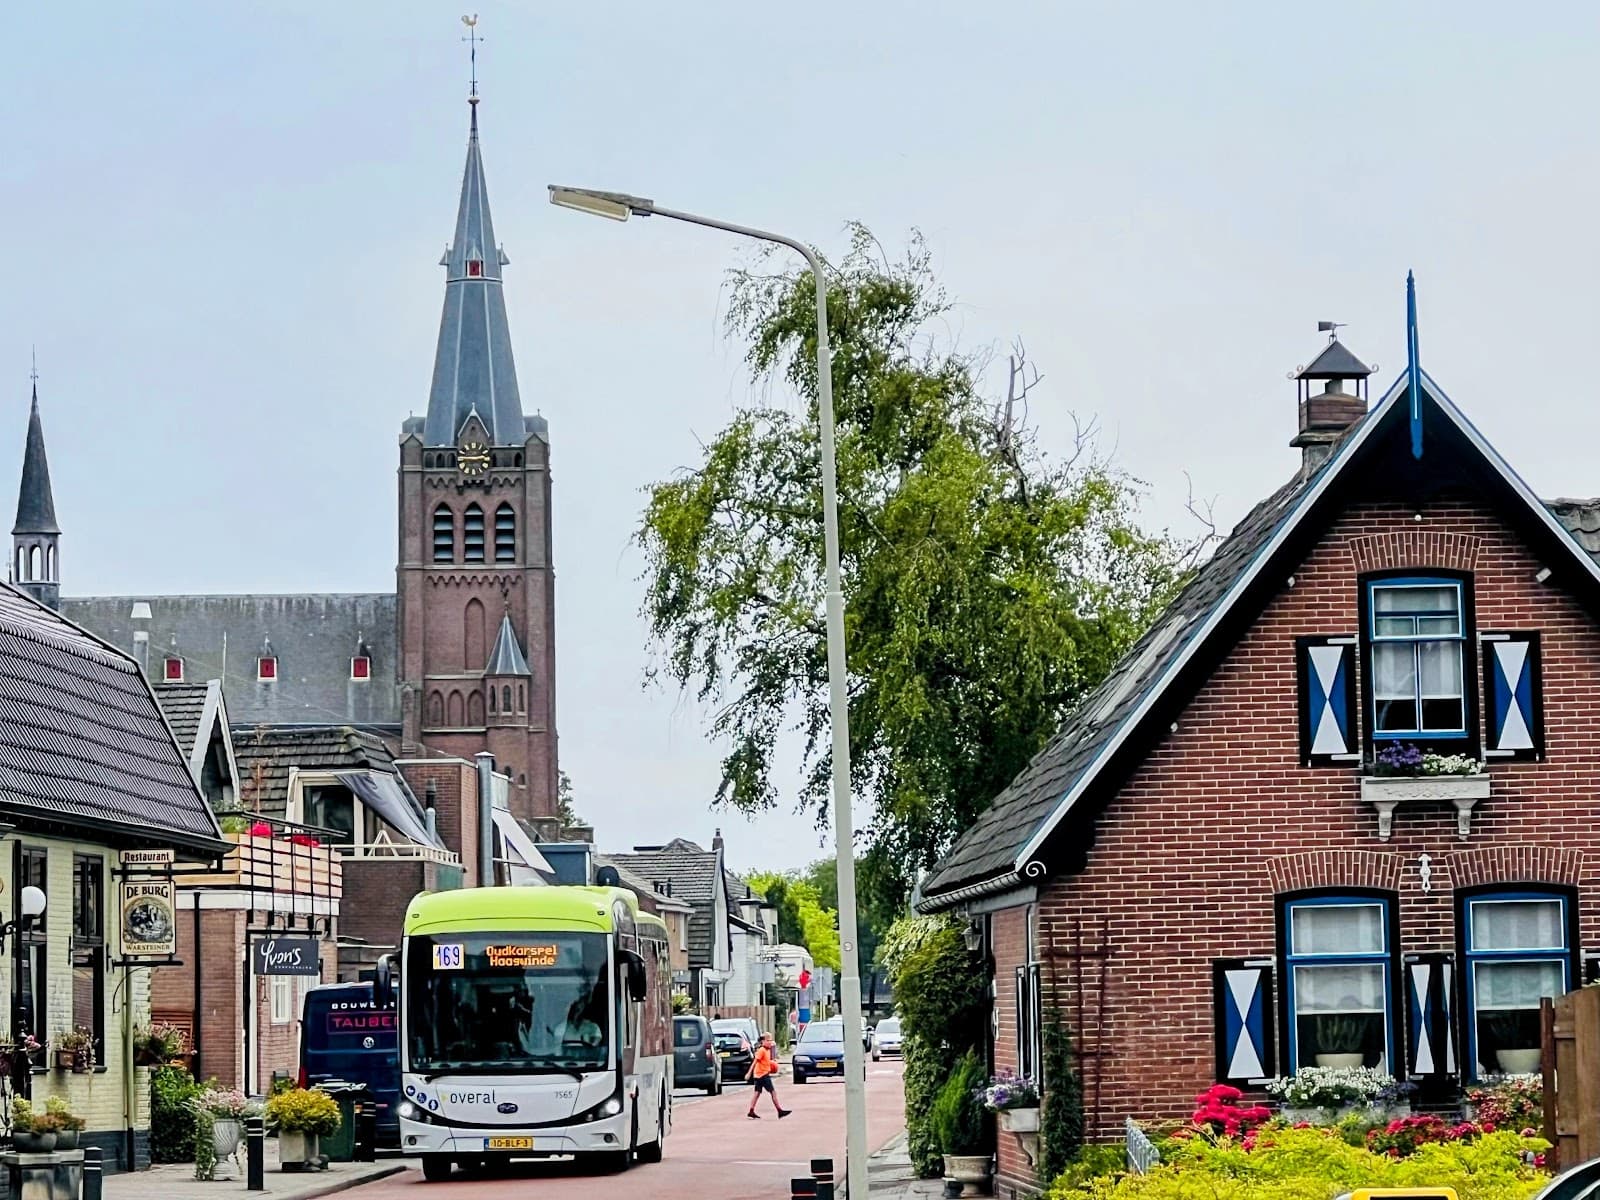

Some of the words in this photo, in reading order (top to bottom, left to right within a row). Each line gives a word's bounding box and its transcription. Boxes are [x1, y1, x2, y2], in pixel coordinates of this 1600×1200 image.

[124, 852, 170, 862] Restaurant
[126, 886, 139, 899] DE
[142, 886, 169, 898] BURG
[436, 946, 460, 966] 169
[450, 1088, 497, 1104] overal
